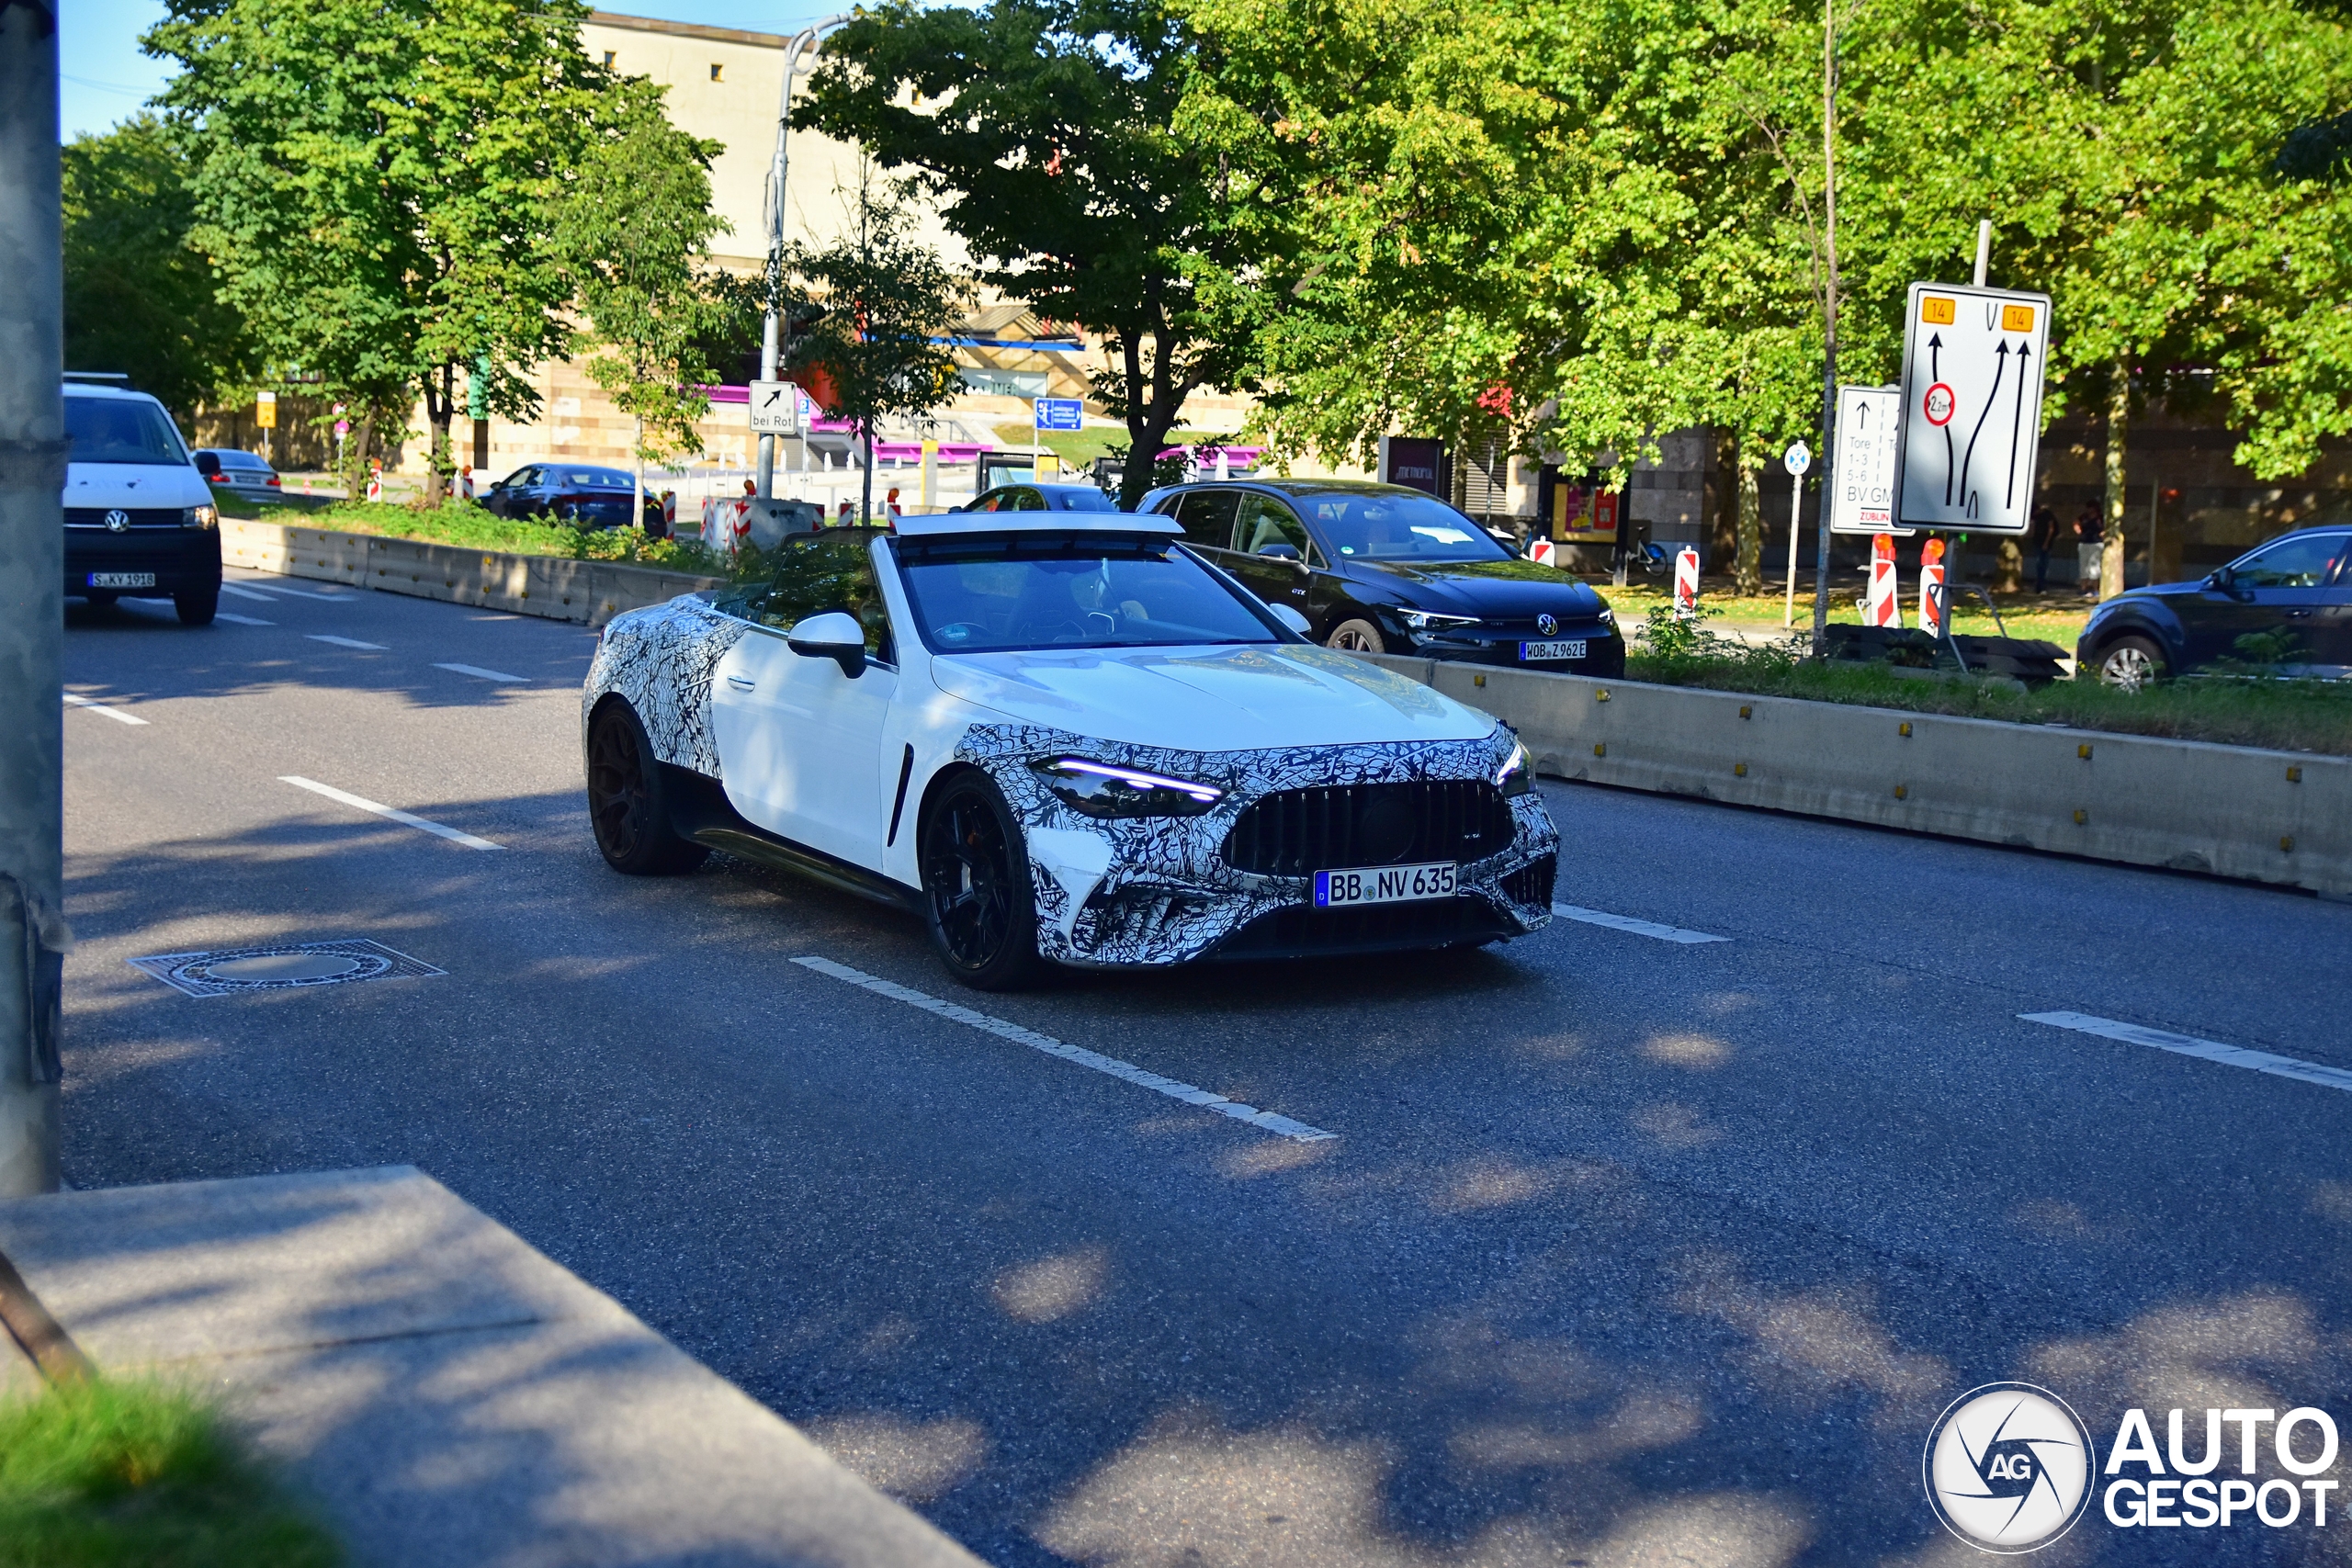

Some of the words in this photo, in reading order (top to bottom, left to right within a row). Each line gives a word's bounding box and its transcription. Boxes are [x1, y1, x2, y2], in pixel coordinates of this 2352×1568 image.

[1933, 302, 1945, 320] 14
[2012, 310, 2025, 327] 14
[753, 415, 769, 425] bei
[775, 416, 791, 427] Rot
[1849, 436, 1871, 449] Tore
[1848, 486, 1867, 502] BV
[94, 575, 102, 584] S
[108, 575, 124, 584] KY
[127, 575, 154, 585] 1918
[1527, 644, 1546, 658] WOB
[1553, 644, 1559, 657] Z
[1560, 643, 1578, 657] 962
[1579, 643, 1586, 656] E
[1318, 892, 1325, 901] D
[1331, 874, 1362, 901] BB
[1378, 870, 1408, 898] NV
[1412, 866, 1454, 896] 635
